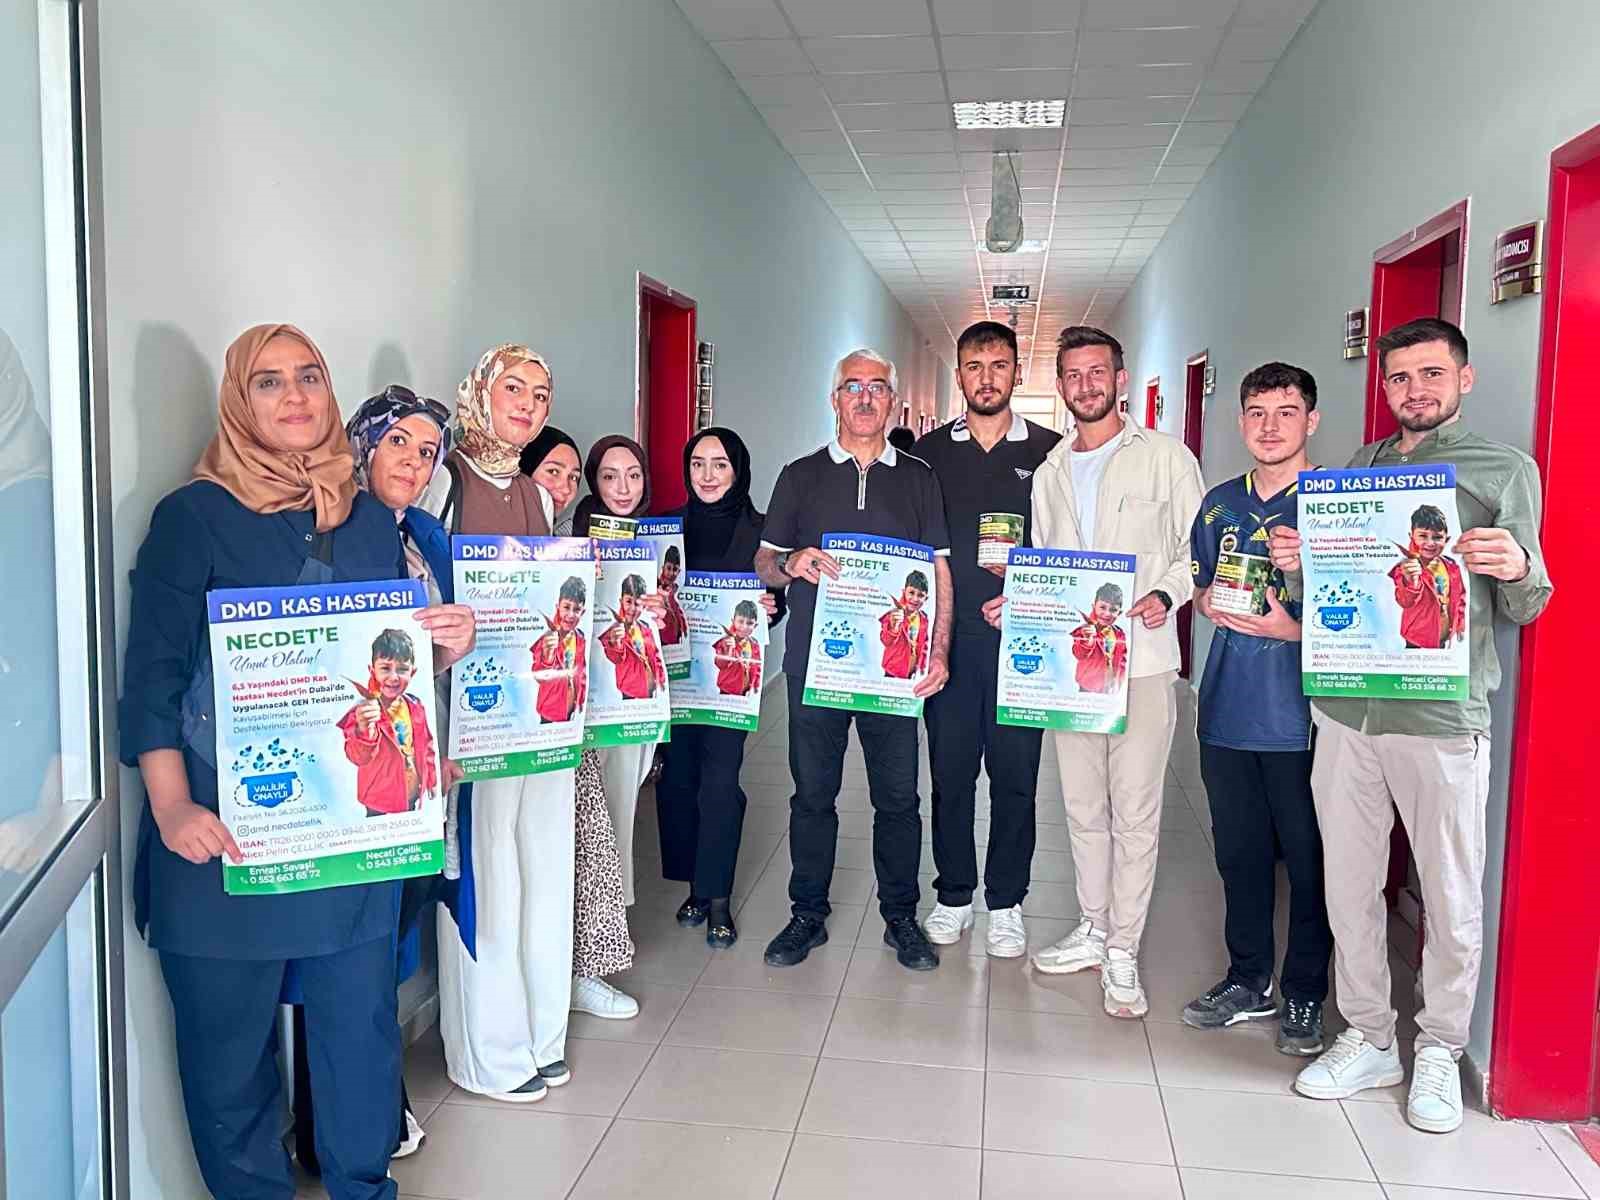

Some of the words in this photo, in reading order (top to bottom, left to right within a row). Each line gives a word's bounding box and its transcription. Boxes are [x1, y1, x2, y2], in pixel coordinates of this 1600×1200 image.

[1305, 479, 1336, 492] DMD
[1342, 477, 1372, 490] KAS
[1375, 474, 1446, 489] HASTASI!
[1306, 501, 1385, 515] NECDET'E
[462, 545, 498, 558] DMD
[829, 540, 856, 549] DMD
[861, 541, 883, 552] KAS
[885, 545, 929, 560] HASTASI!
[836, 556, 890, 571] ECDET'E
[1014, 554, 1041, 565] DMD
[1046, 556, 1070, 566] KAS
[1073, 558, 1128, 571] HASTASI!
[689, 577, 710, 586] KAS
[713, 579, 760, 588] HASTASI!
[1012, 573, 1078, 586] NECDET'E
[678, 592, 718, 603] CDET'E
[221, 601, 272, 620] DMD
[281, 596, 321, 615] KAS
[326, 590, 413, 611] HASTASI!
[226, 626, 339, 651] NECDET'E
[291, 676, 310, 684] DMD
[233, 701, 288, 713] Uygulanacak
[291, 698, 309, 706] GEN
[311, 693, 355, 704] Tedavisine
[366, 847, 395, 860] Necati
[249, 866, 280, 875] Emrah
